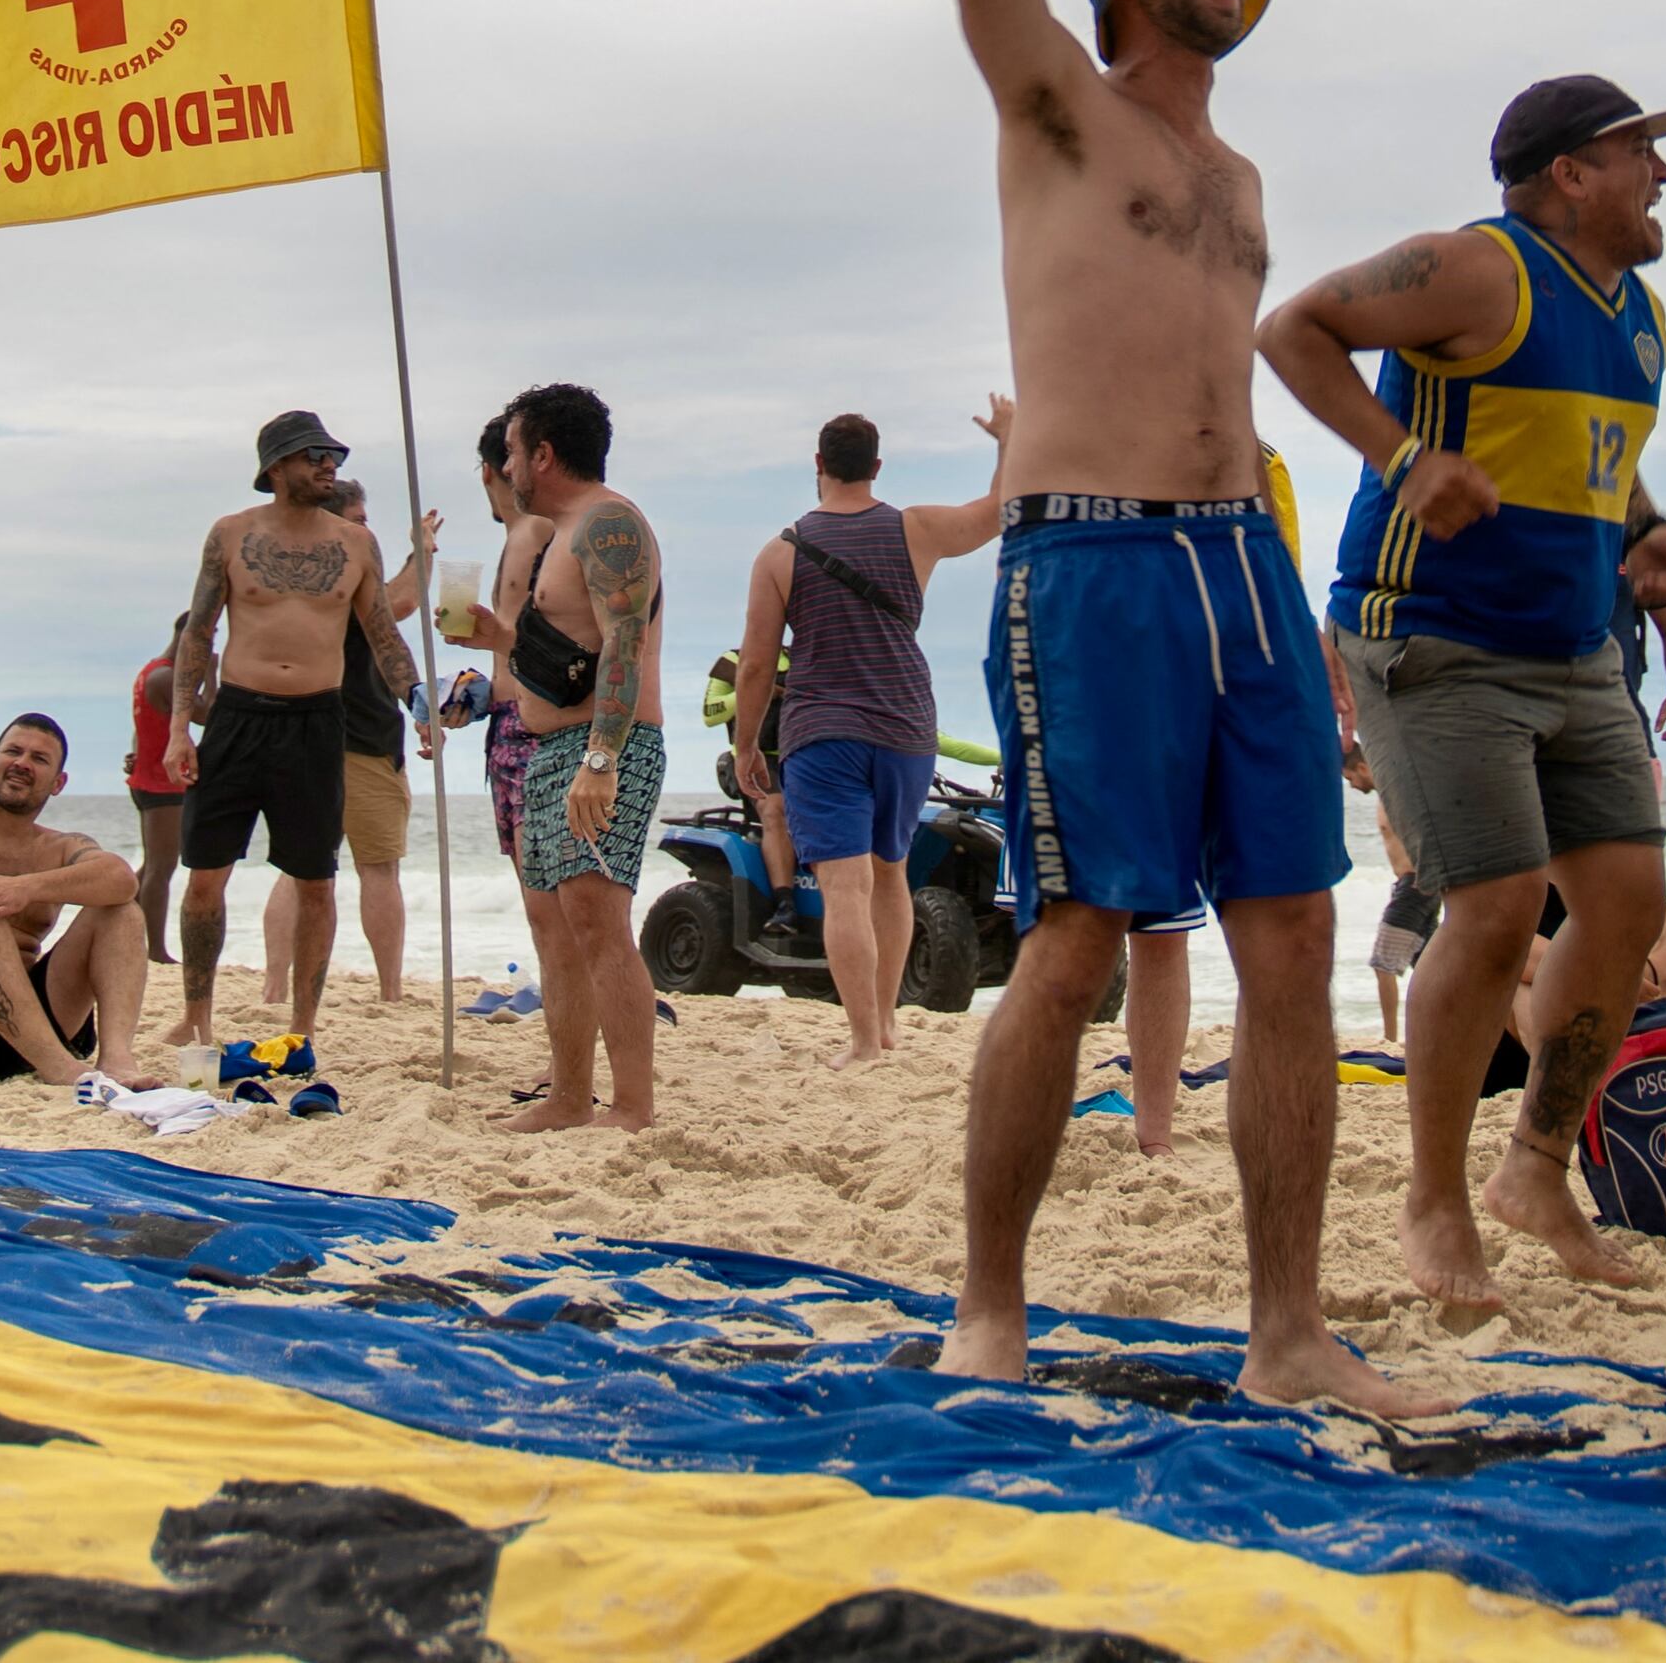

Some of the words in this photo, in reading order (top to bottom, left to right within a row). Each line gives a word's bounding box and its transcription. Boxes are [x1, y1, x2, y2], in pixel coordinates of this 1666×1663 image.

[1587, 415, 1628, 495] 12
[595, 532, 638, 550] CABJ
[1009, 624, 1033, 677] THE
[1014, 679, 1041, 735] NOT
[1035, 833, 1068, 894] AND
